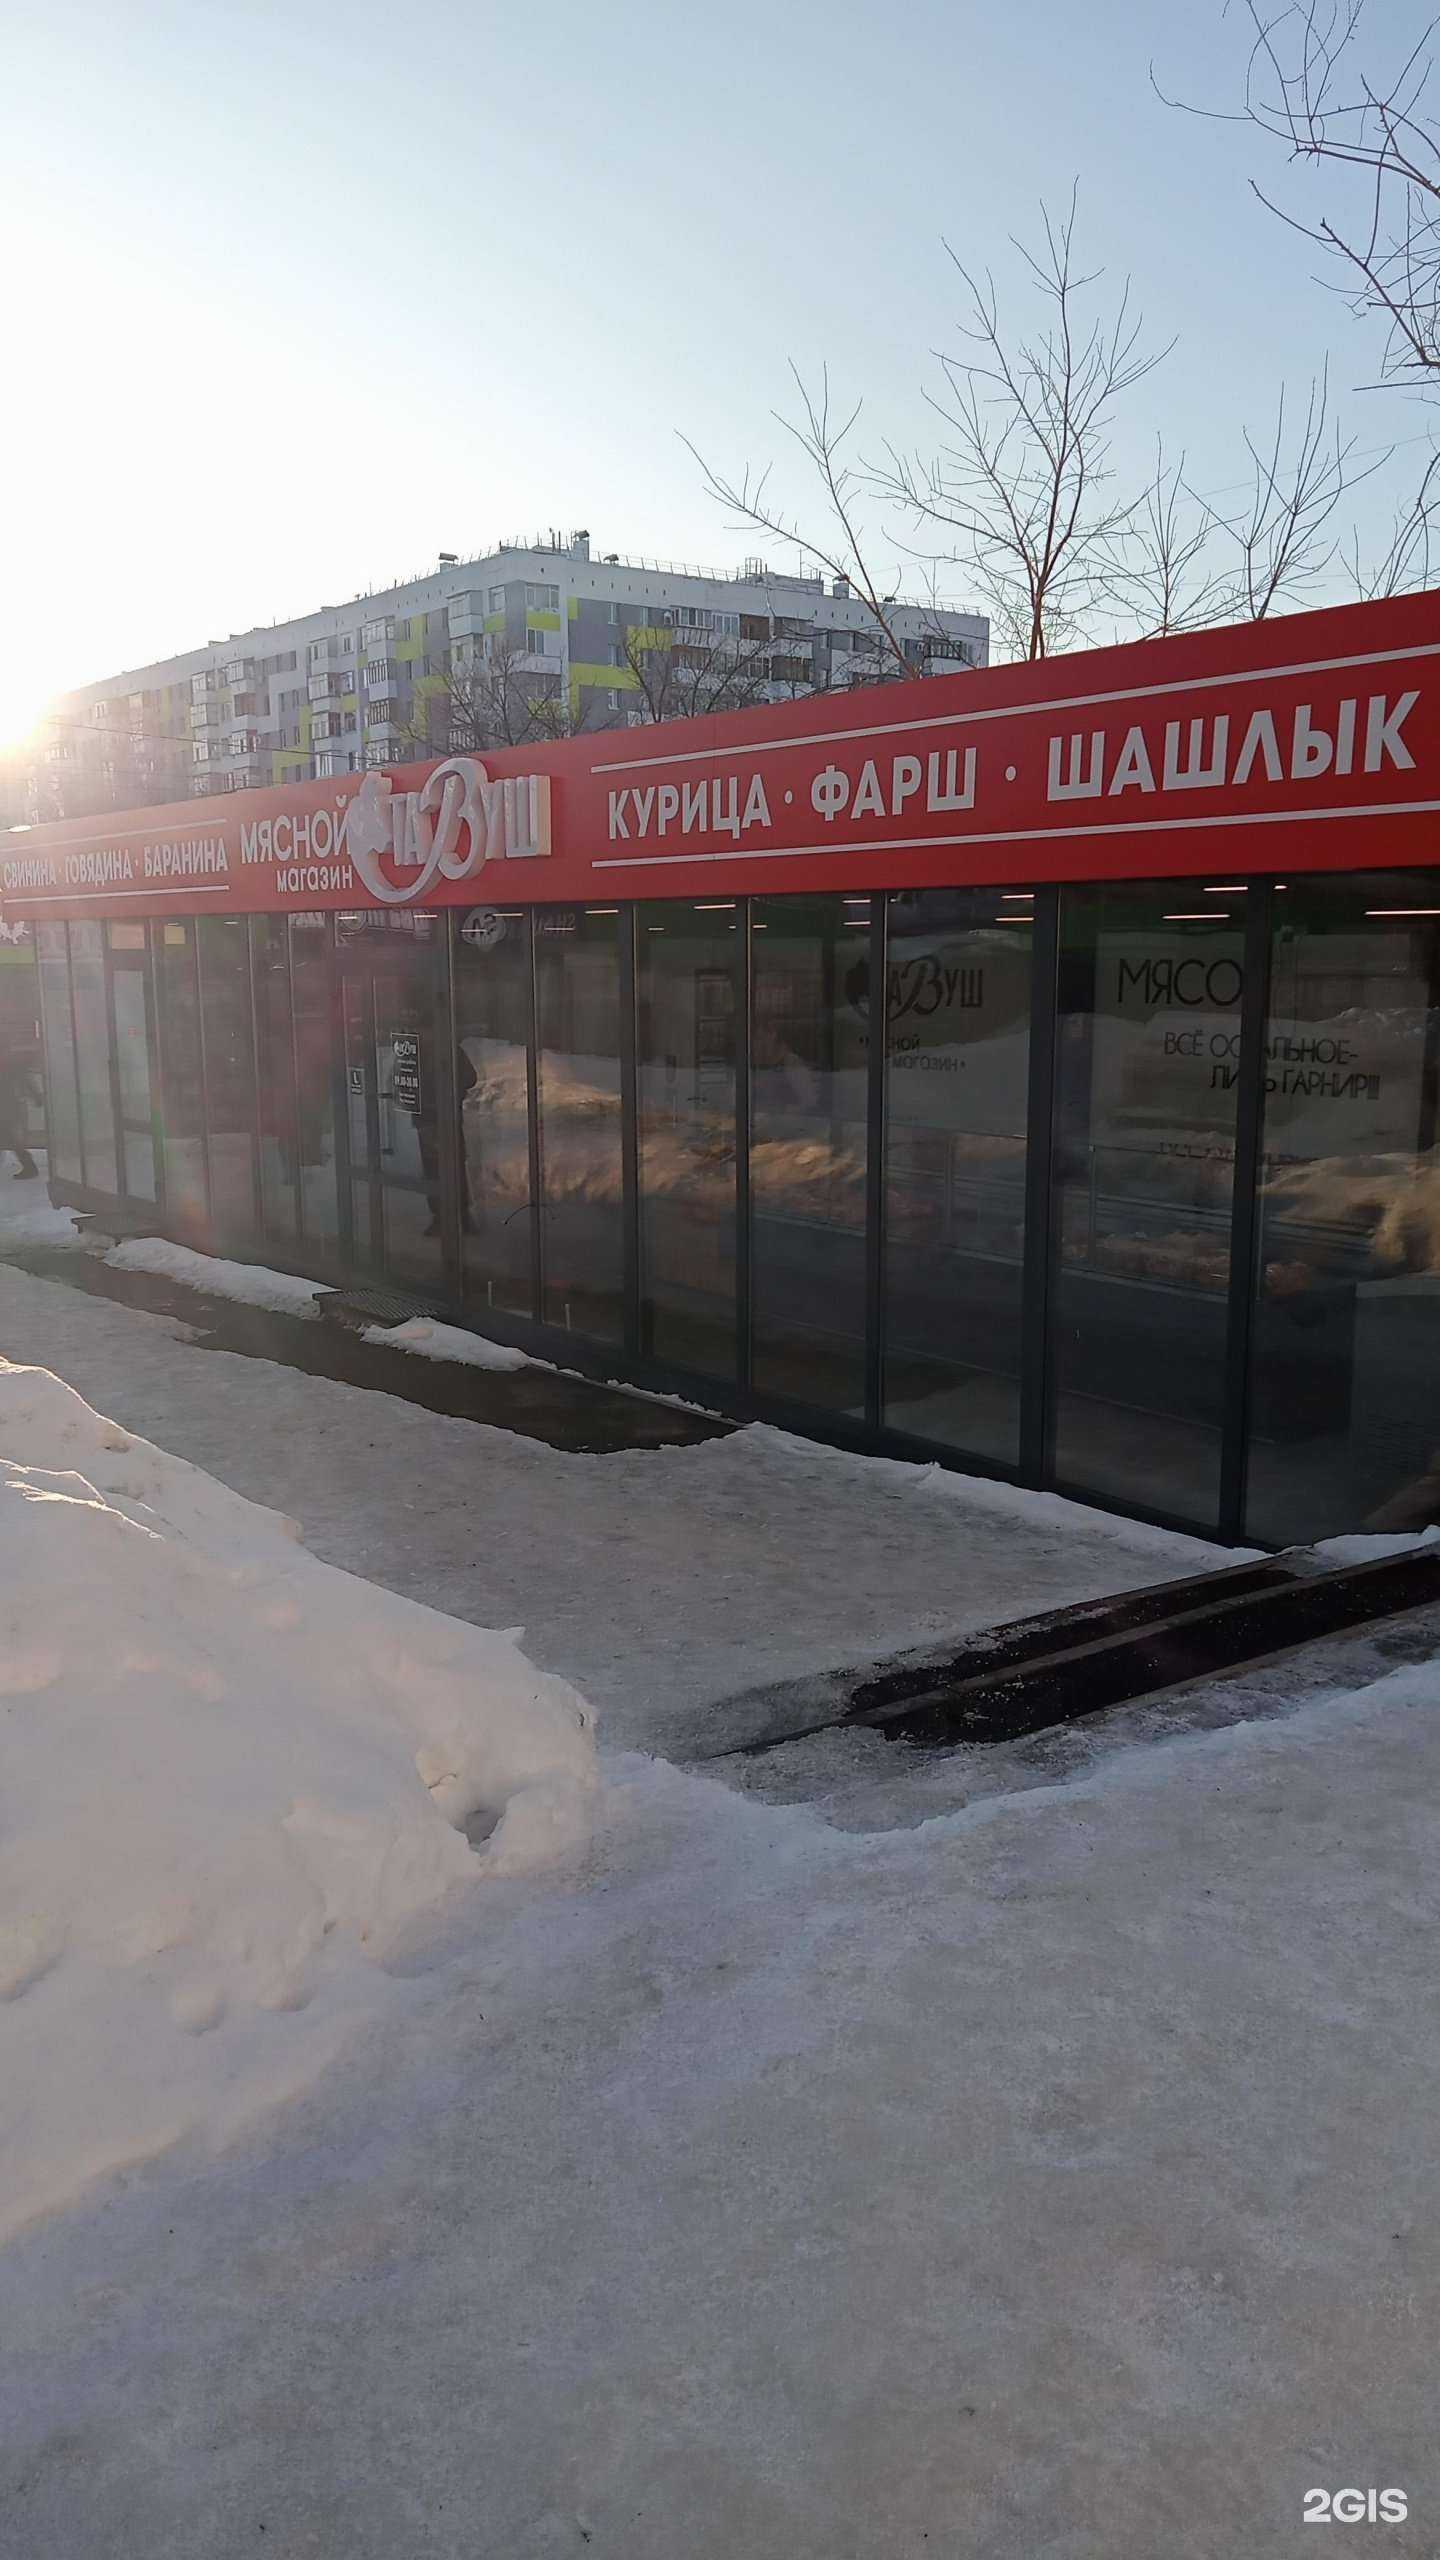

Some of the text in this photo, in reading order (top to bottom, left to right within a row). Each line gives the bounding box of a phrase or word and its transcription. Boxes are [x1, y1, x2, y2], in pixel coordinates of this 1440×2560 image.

[608, 691, 1421, 842] КУРИЦА ФАРШ ШАШЛЫК
[240, 796, 353, 865] МЯСНОЙ
[3, 838, 228, 889] СВИНИНА ГОВЯДИНА БАРАНИНА
[1118, 959, 1242, 1007] МЯСО
[1163, 1030, 1203, 1057] ВСЁ
